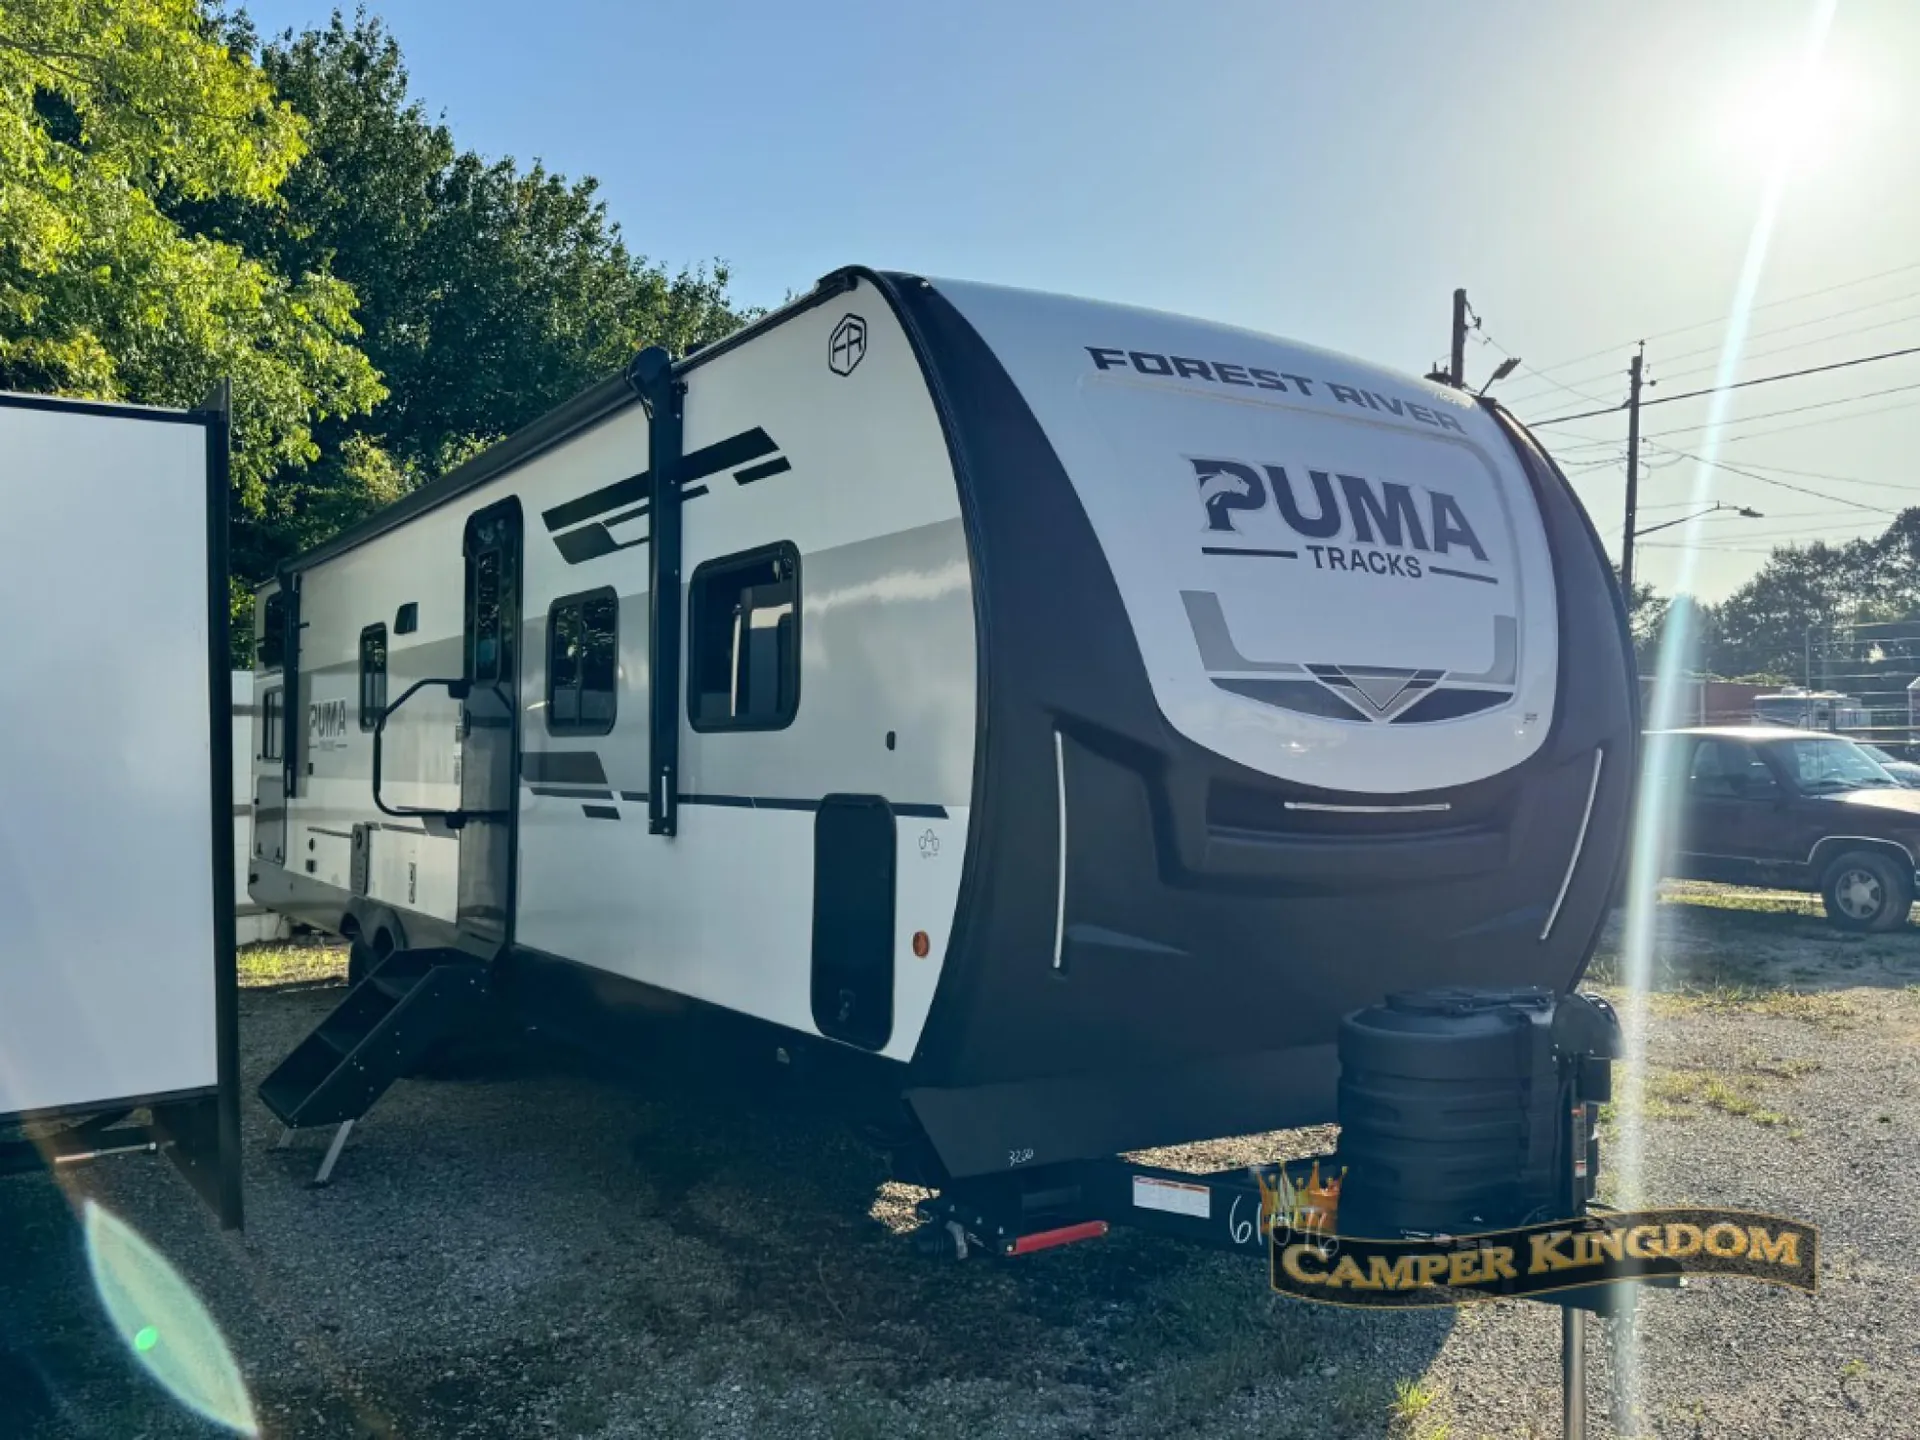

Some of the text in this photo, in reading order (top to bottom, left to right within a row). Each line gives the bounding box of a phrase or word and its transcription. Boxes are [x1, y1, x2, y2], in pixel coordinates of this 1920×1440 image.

[1084, 346, 1467, 434] FOREST RIVER
[1188, 458, 1489, 562] PUMA
[1306, 545, 1423, 579] TRACKS
